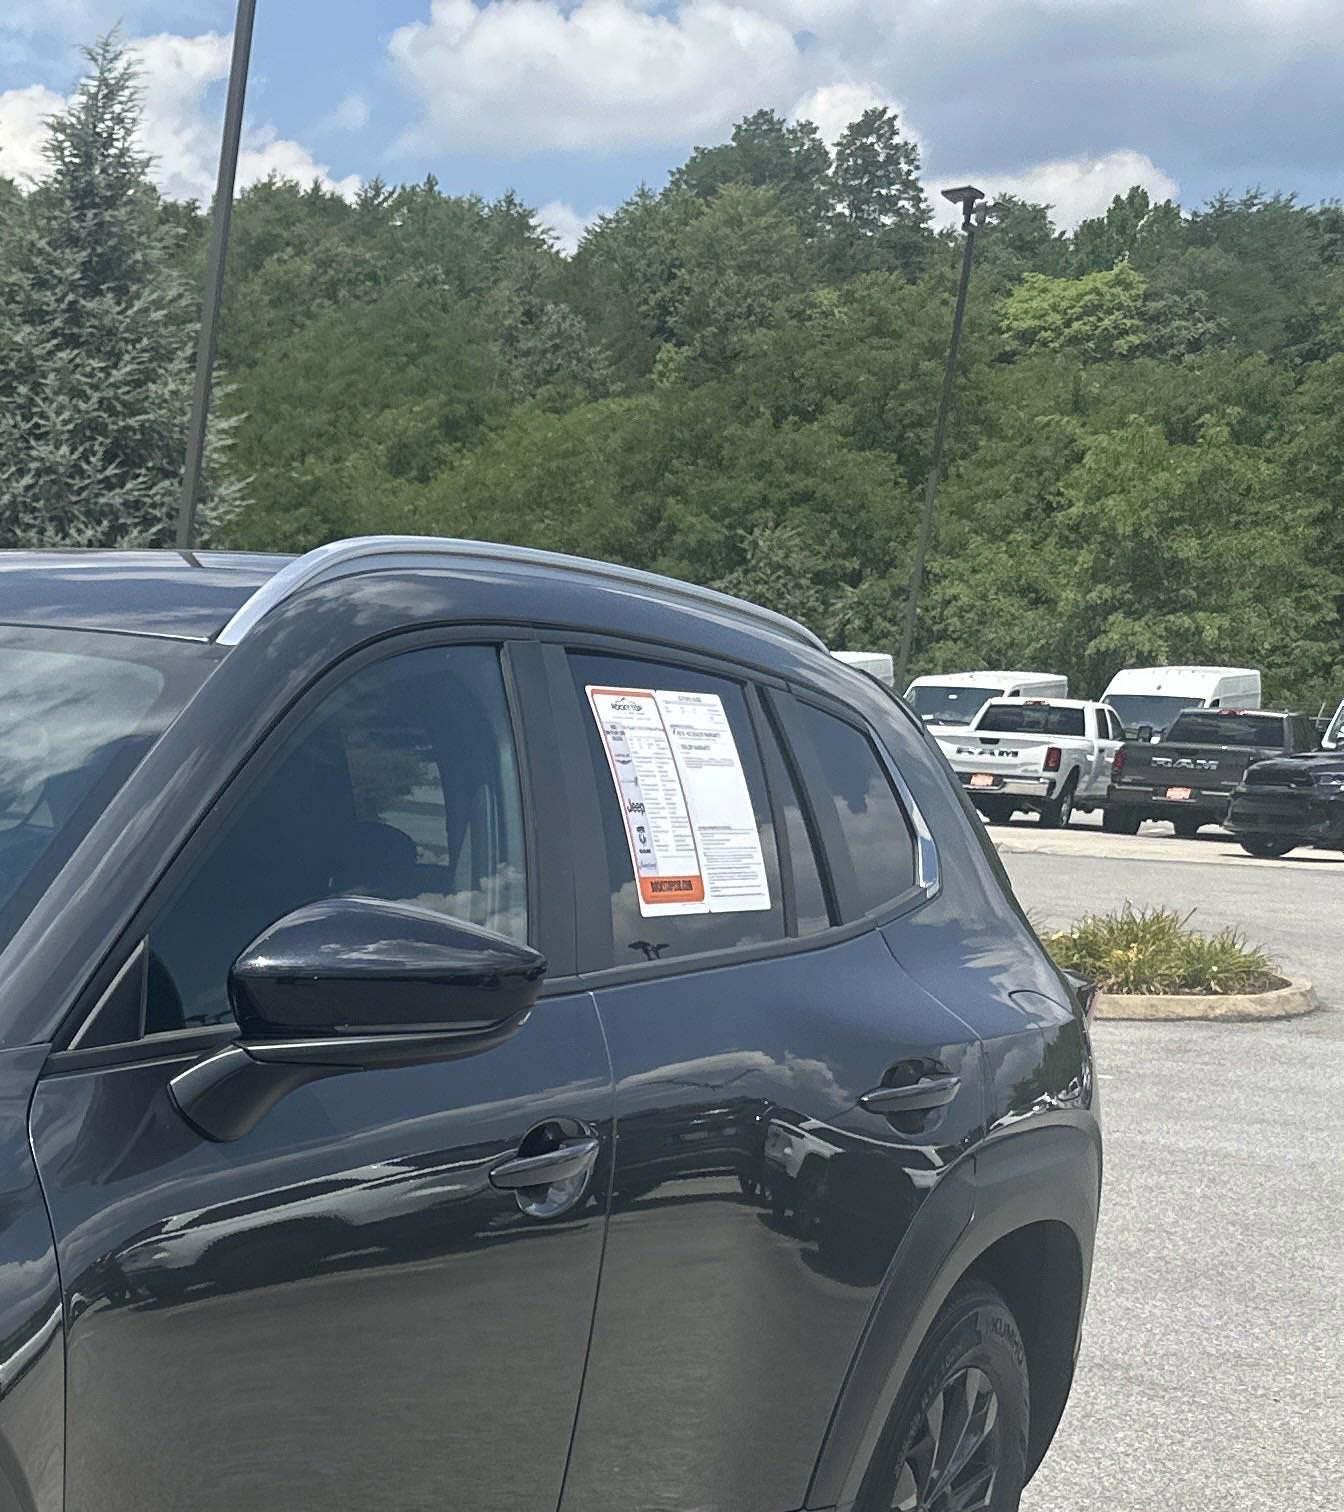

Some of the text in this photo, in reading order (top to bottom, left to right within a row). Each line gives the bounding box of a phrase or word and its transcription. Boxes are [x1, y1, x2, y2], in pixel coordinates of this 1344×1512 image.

[955, 746, 1020, 758] RAM
[1151, 757, 1220, 770] RAM
[627, 798, 646, 816] Jeep
